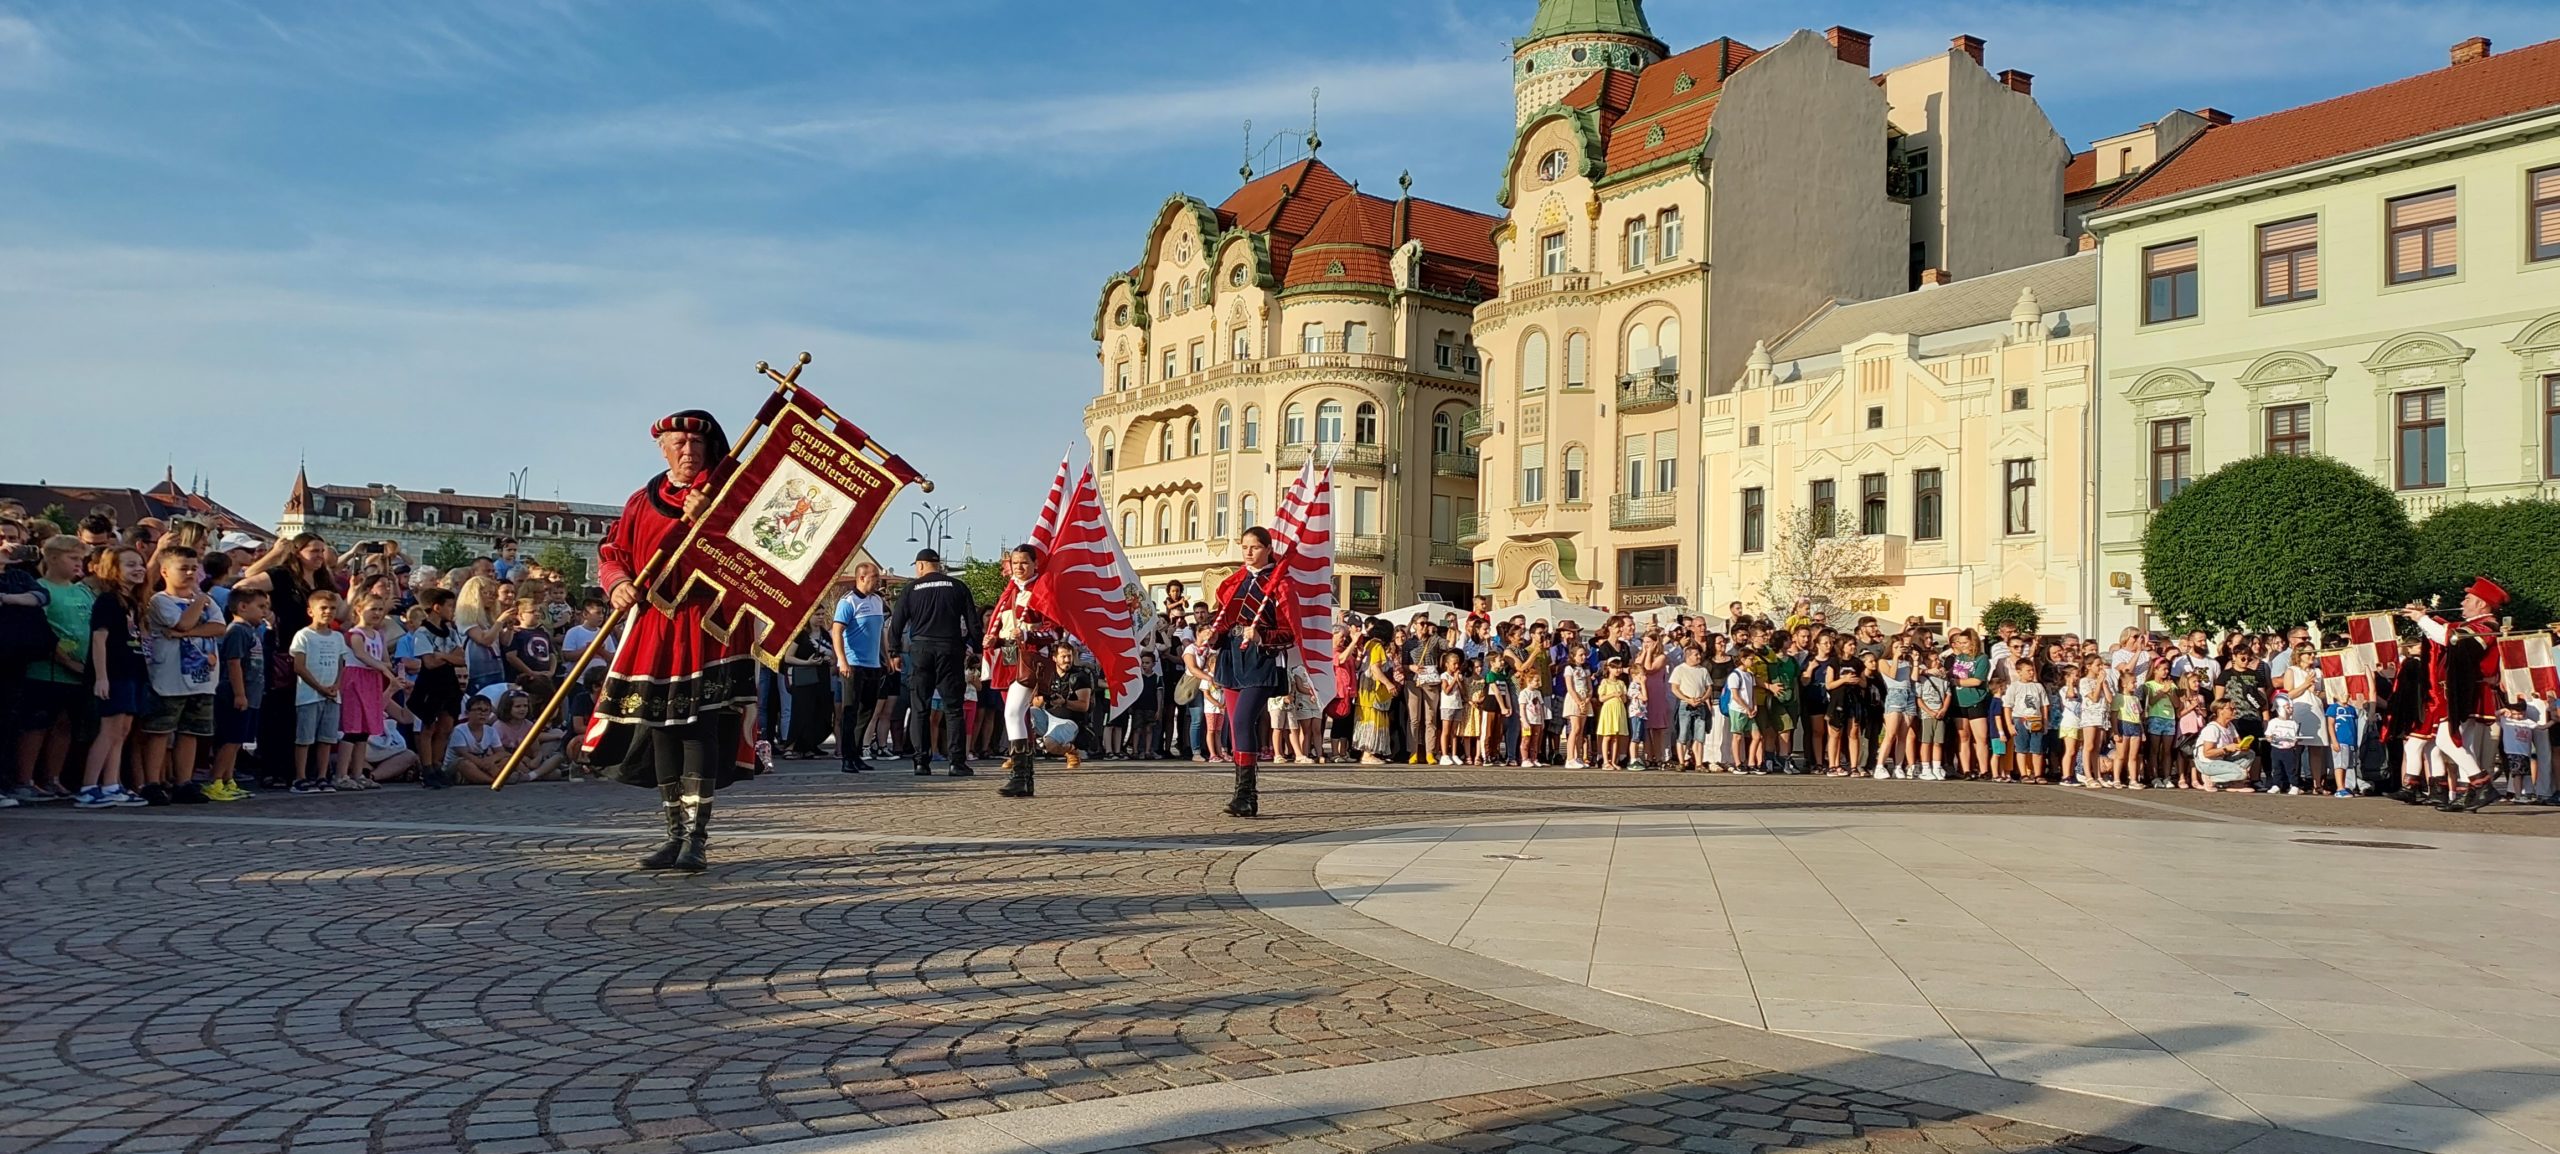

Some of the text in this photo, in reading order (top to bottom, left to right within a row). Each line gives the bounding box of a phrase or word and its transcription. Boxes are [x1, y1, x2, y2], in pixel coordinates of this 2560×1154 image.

[787, 440, 867, 498] Sbandieratori
[792, 423, 881, 488] Gruppo Storico
[696, 537, 792, 608] Castiglion Fiorentino
[758, 566, 767, 576] di
[913, 580, 953, 591] JANDARMERIA
[1623, 594, 1669, 606] FIRSTBAN
